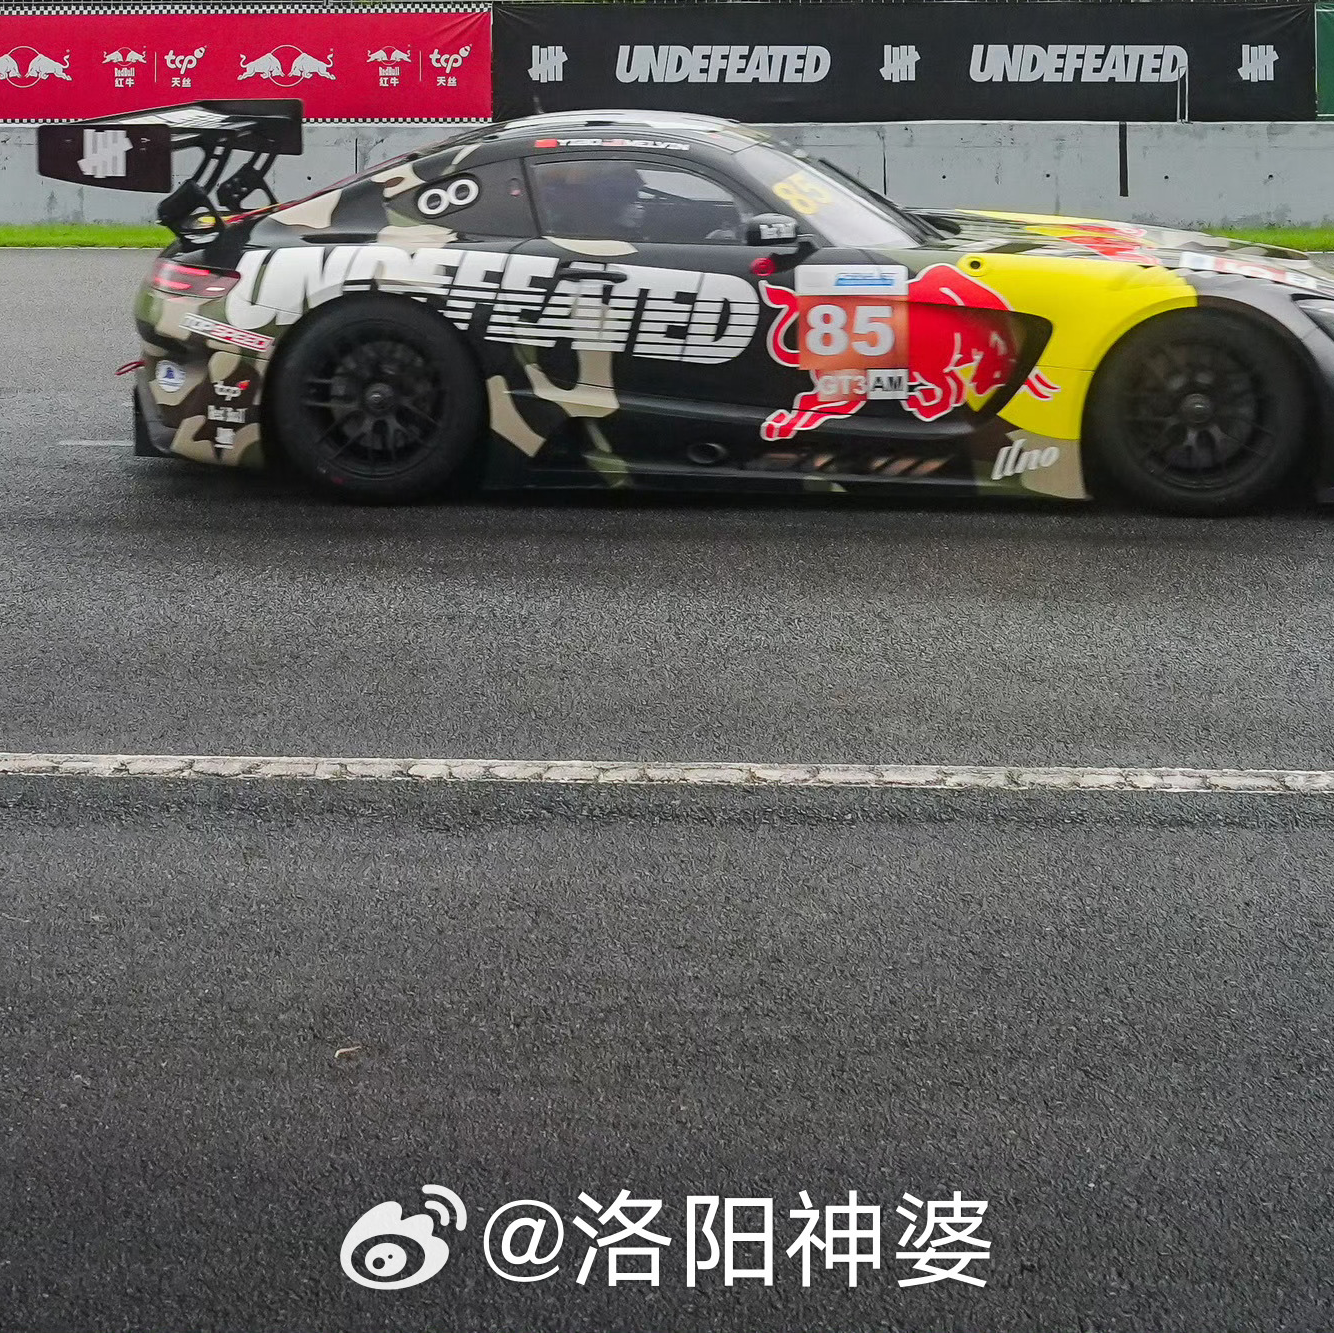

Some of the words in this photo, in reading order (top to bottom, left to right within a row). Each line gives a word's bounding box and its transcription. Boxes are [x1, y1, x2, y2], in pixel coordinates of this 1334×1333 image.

[164, 49, 198, 75] tcp
[429, 48, 463, 74] tcp
[615, 43, 832, 83] UNDEFEATED
[969, 43, 1188, 83] UNDEFEATED
[114, 77, 135, 88] 红牛
[171, 77, 192, 88] 天丝
[379, 76, 399, 87] 红牛
[436, 76, 457, 87] 天丝
[772, 170, 830, 215] 85
[805, 304, 896, 357] 85
[818, 375, 866, 395] GT3
[871, 375, 904, 392] AM
